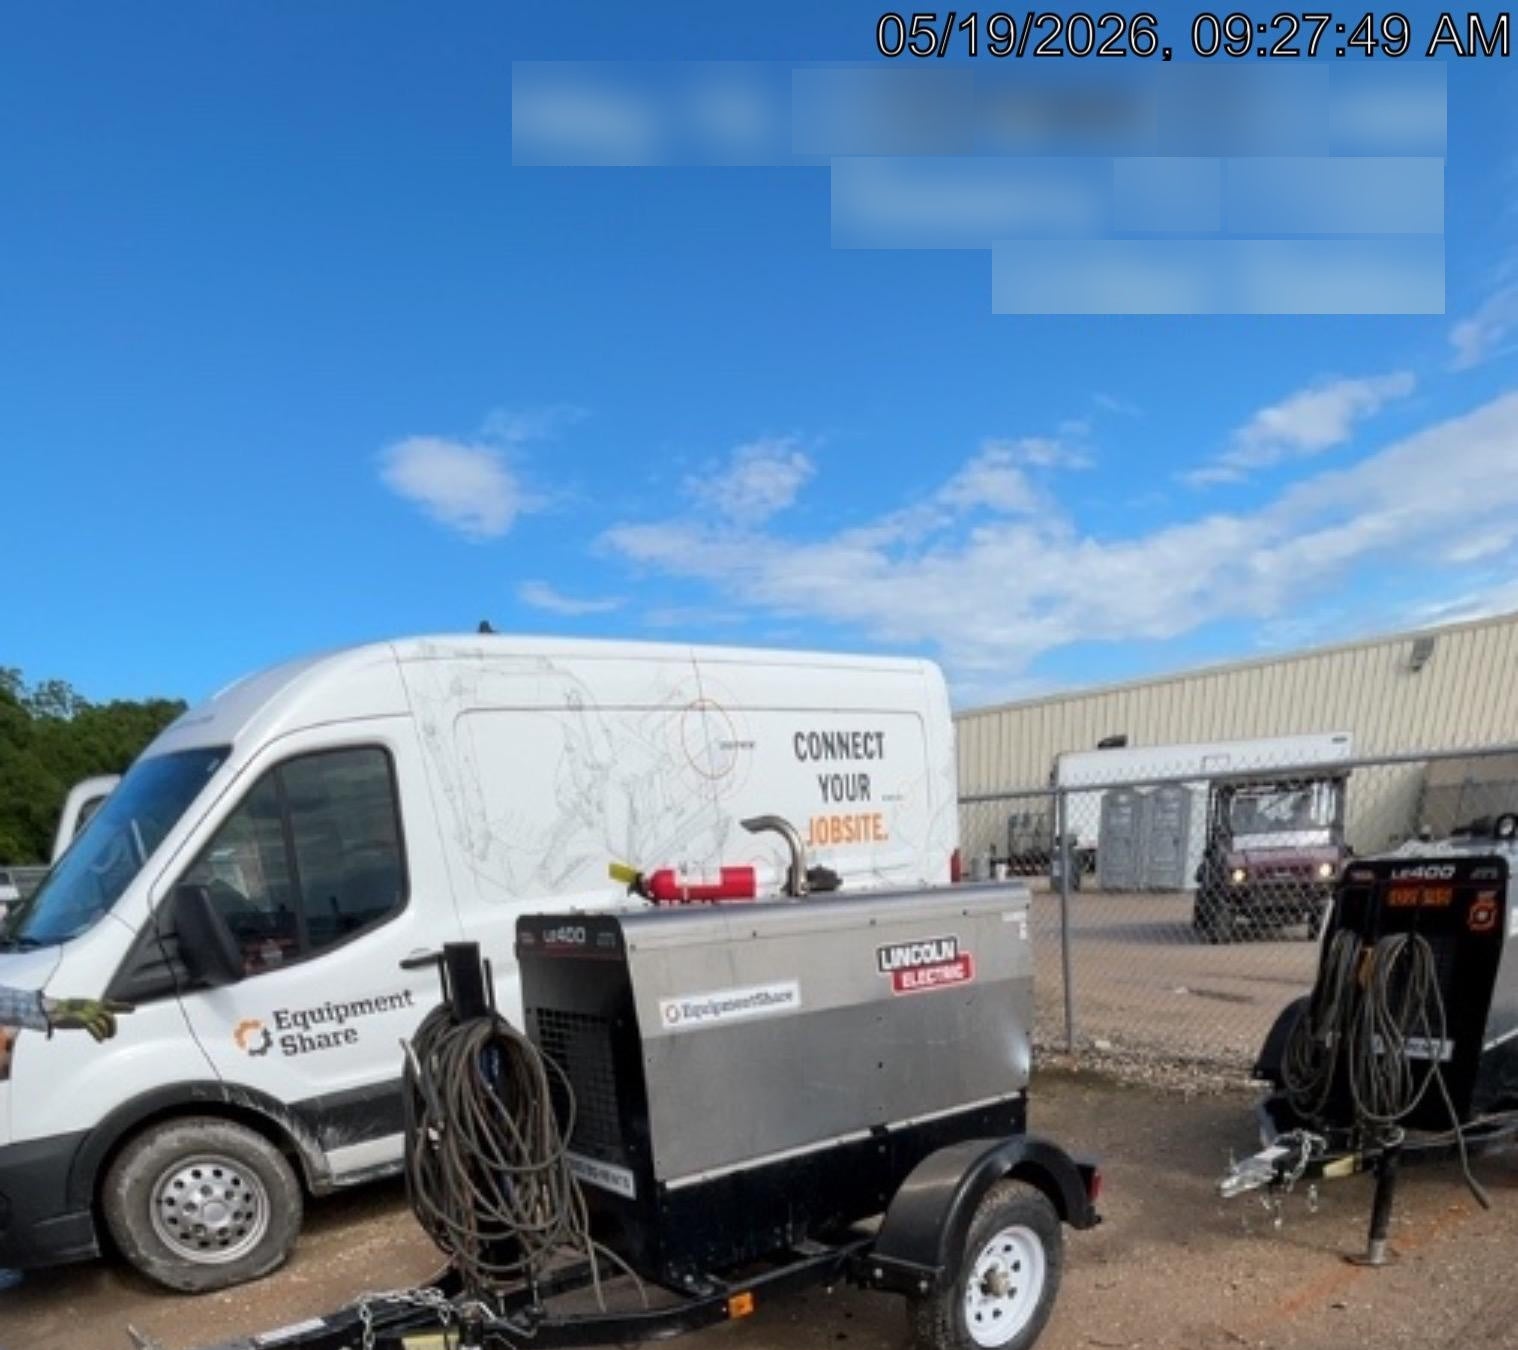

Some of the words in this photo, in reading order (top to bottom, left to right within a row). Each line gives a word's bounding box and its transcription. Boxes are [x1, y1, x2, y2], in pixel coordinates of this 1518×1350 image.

[793, 731, 885, 762] CONNECT
[818, 773, 872, 803] YOUR
[806, 813, 889, 846] JOBSITE.
[881, 940, 956, 970] LINCOLN
[902, 961, 965, 988] ELECTRIC
[273, 988, 415, 1030] Equipment
[279, 1026, 359, 1056] Share
